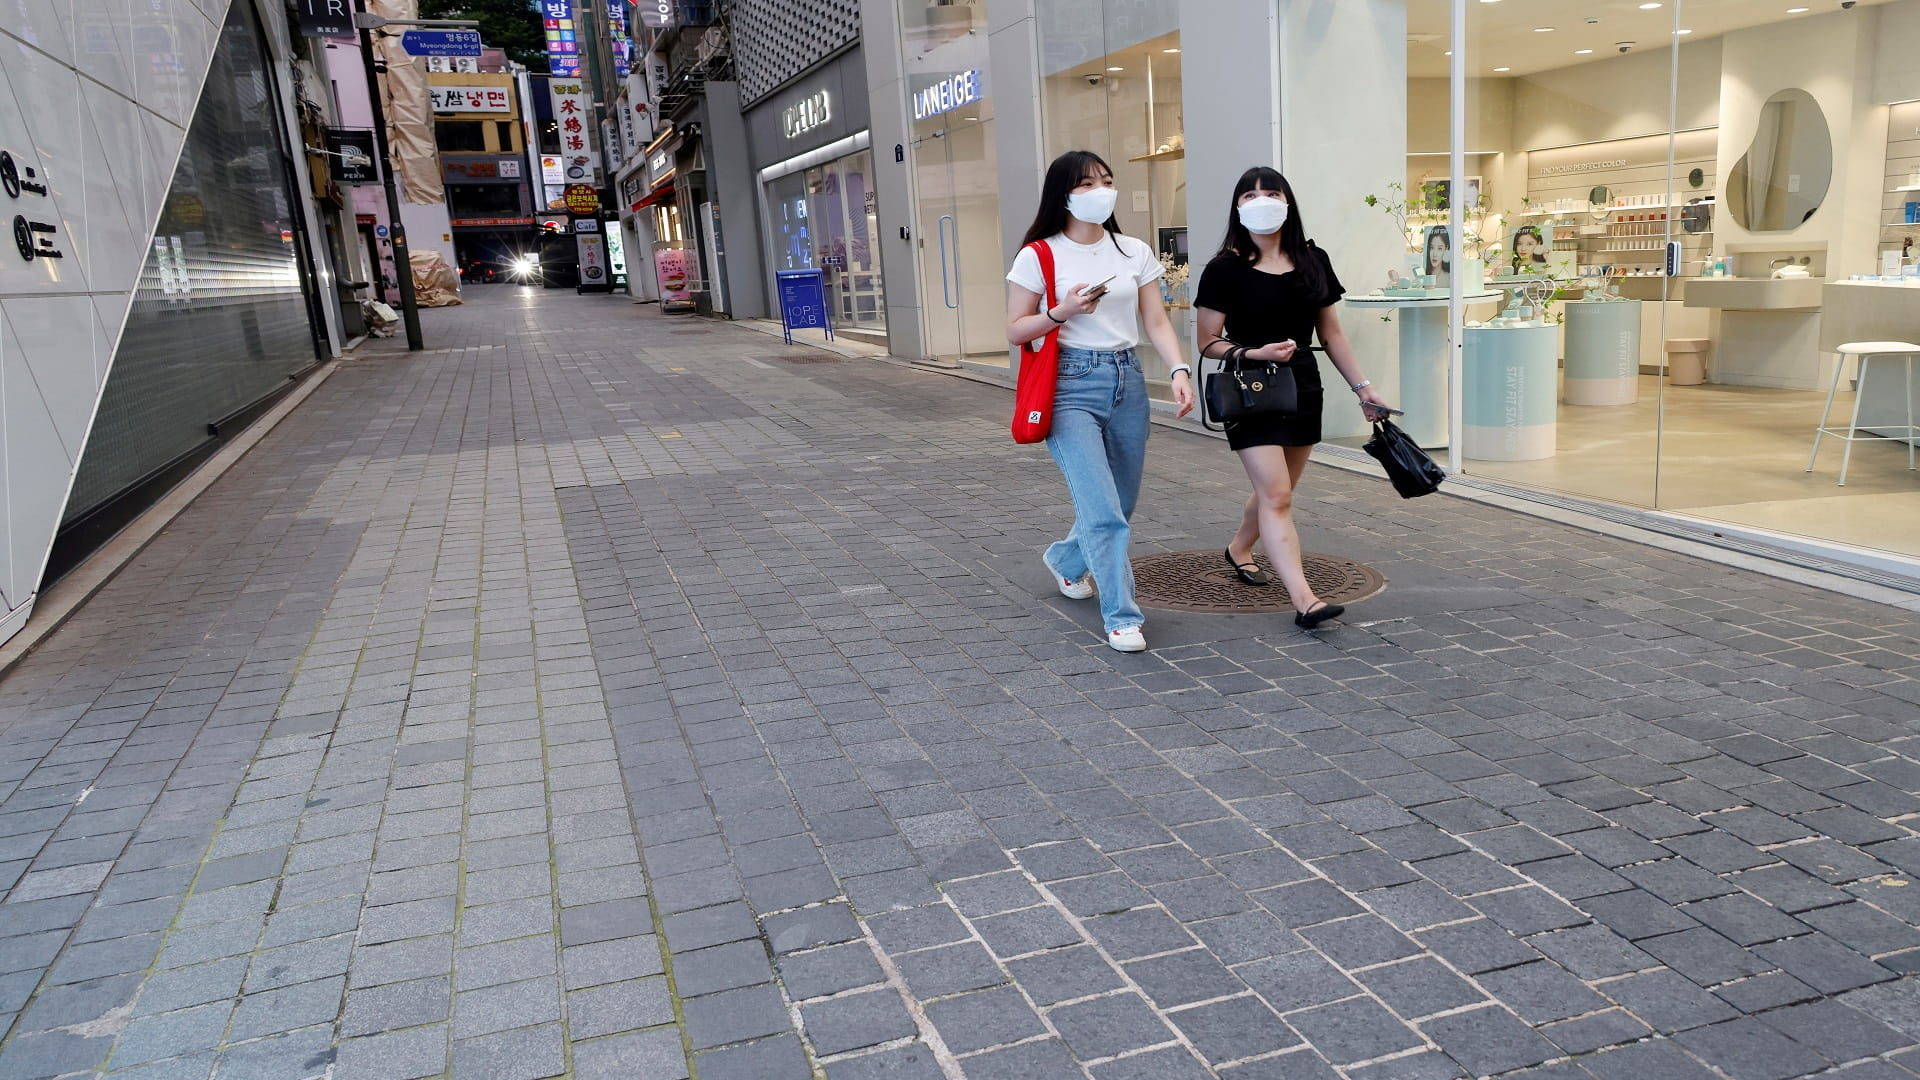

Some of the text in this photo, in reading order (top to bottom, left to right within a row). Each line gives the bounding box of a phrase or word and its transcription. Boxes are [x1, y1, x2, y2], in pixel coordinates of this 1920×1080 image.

[547, 3, 569, 18] 방
[657, 0, 669, 24] OP
[445, 33, 478, 43] 명동6길
[420, 42, 462, 50] Myeongdong
[913, 70, 975, 119] LANEIGE
[1556, 165, 1573, 173] YOUR
[1573, 162, 1601, 172] PERFECT
[1602, 159, 1627, 169] COLOR
[576, 222, 596, 230] Cafe
[788, 304, 821, 316] IOPE
[789, 314, 817, 326] LAB
[1505, 366, 1518, 389] STAY
[1505, 390, 1517, 404] FIT
[1505, 406, 1517, 428] STAY
